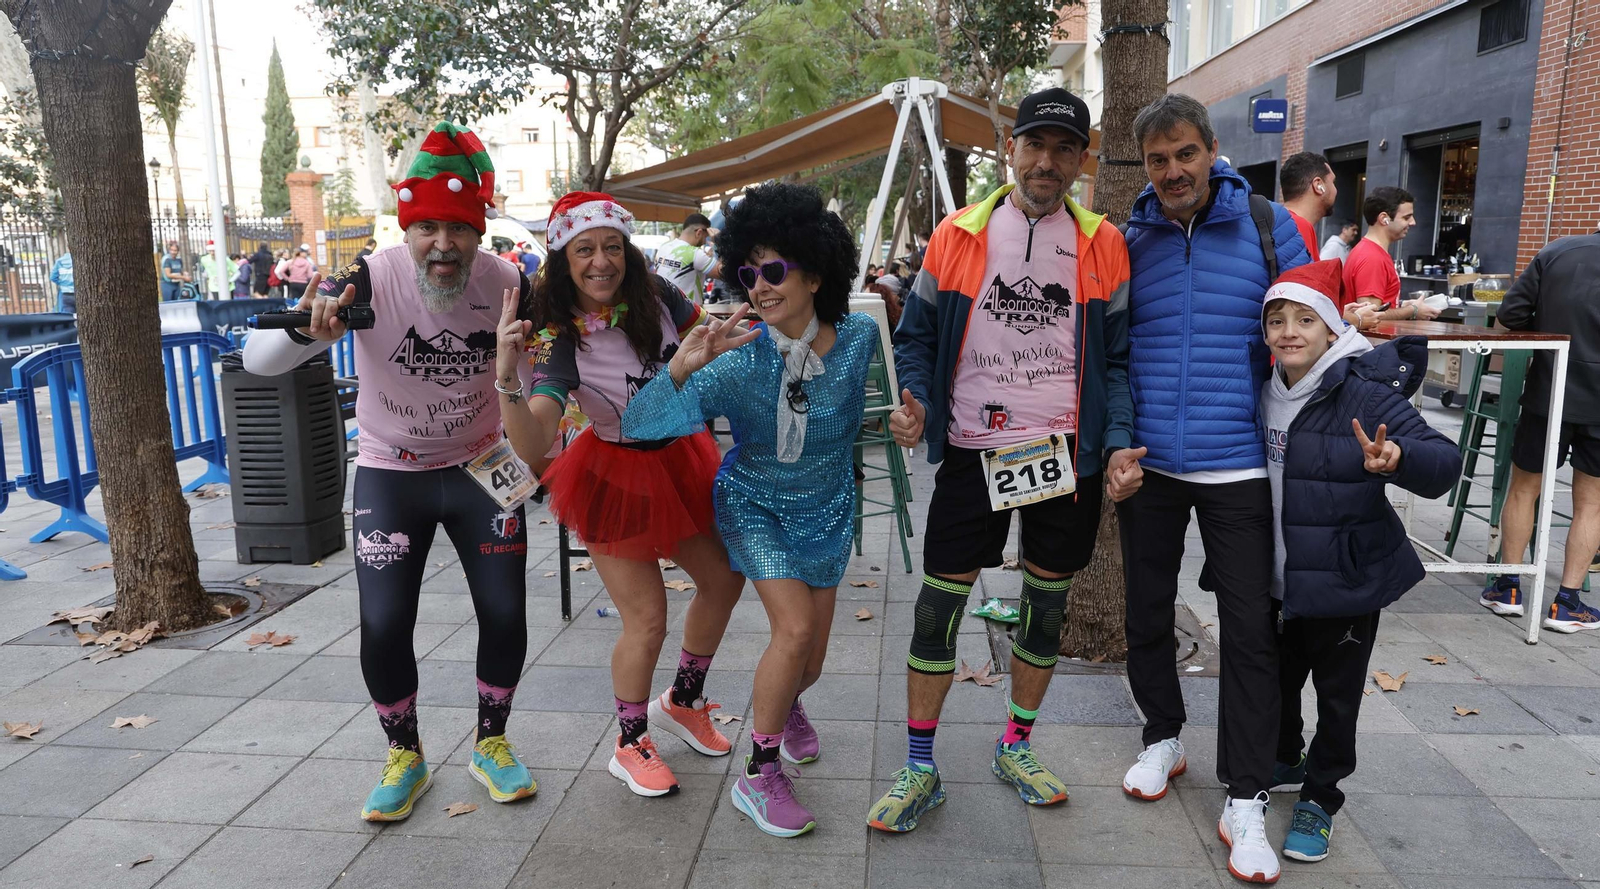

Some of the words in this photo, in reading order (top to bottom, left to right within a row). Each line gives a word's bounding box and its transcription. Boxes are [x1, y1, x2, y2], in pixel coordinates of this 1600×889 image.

[991, 312, 1058, 326] TRAIL
[971, 349, 1004, 369] Una
[404, 366, 487, 376] TRAIL
[996, 367, 1018, 385] mi
[378, 391, 418, 419] Una
[408, 421, 435, 438] mi
[995, 458, 1062, 494] 218
[360, 554, 403, 562] TRAIL
